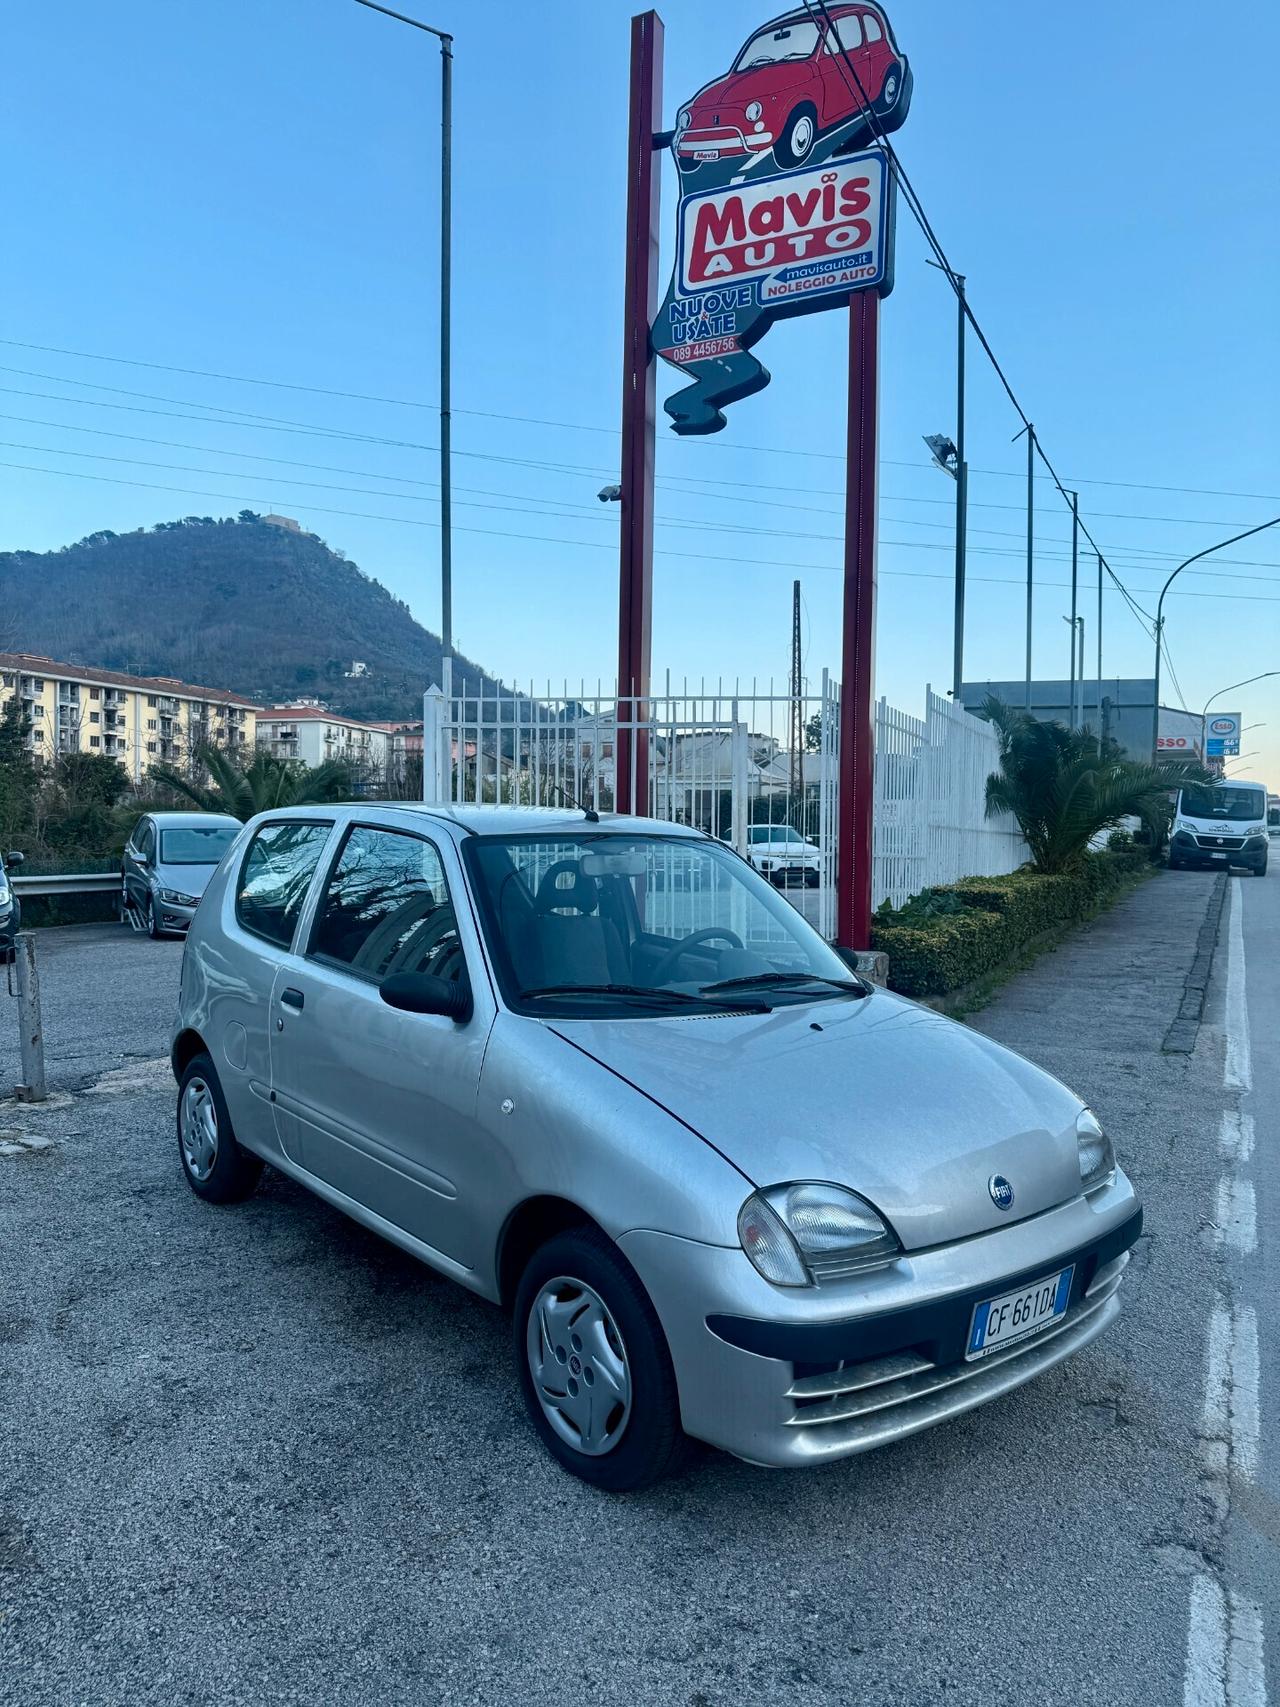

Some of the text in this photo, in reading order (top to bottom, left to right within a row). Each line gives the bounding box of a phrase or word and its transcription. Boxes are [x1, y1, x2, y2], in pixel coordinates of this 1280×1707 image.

[704, 225, 861, 276] AUTO
[768, 266, 876, 297] NOLEGGIO AUTO
[786, 254, 868, 279] mavisauto.it
[669, 286, 751, 322] NUOVE
[672, 312, 736, 344] USATE
[673, 337, 735, 361] 089 4456756
[1157, 737, 1187, 748] SSO
[995, 1184, 1010, 1199] FIAT
[987, 1303, 1010, 1337] CF
